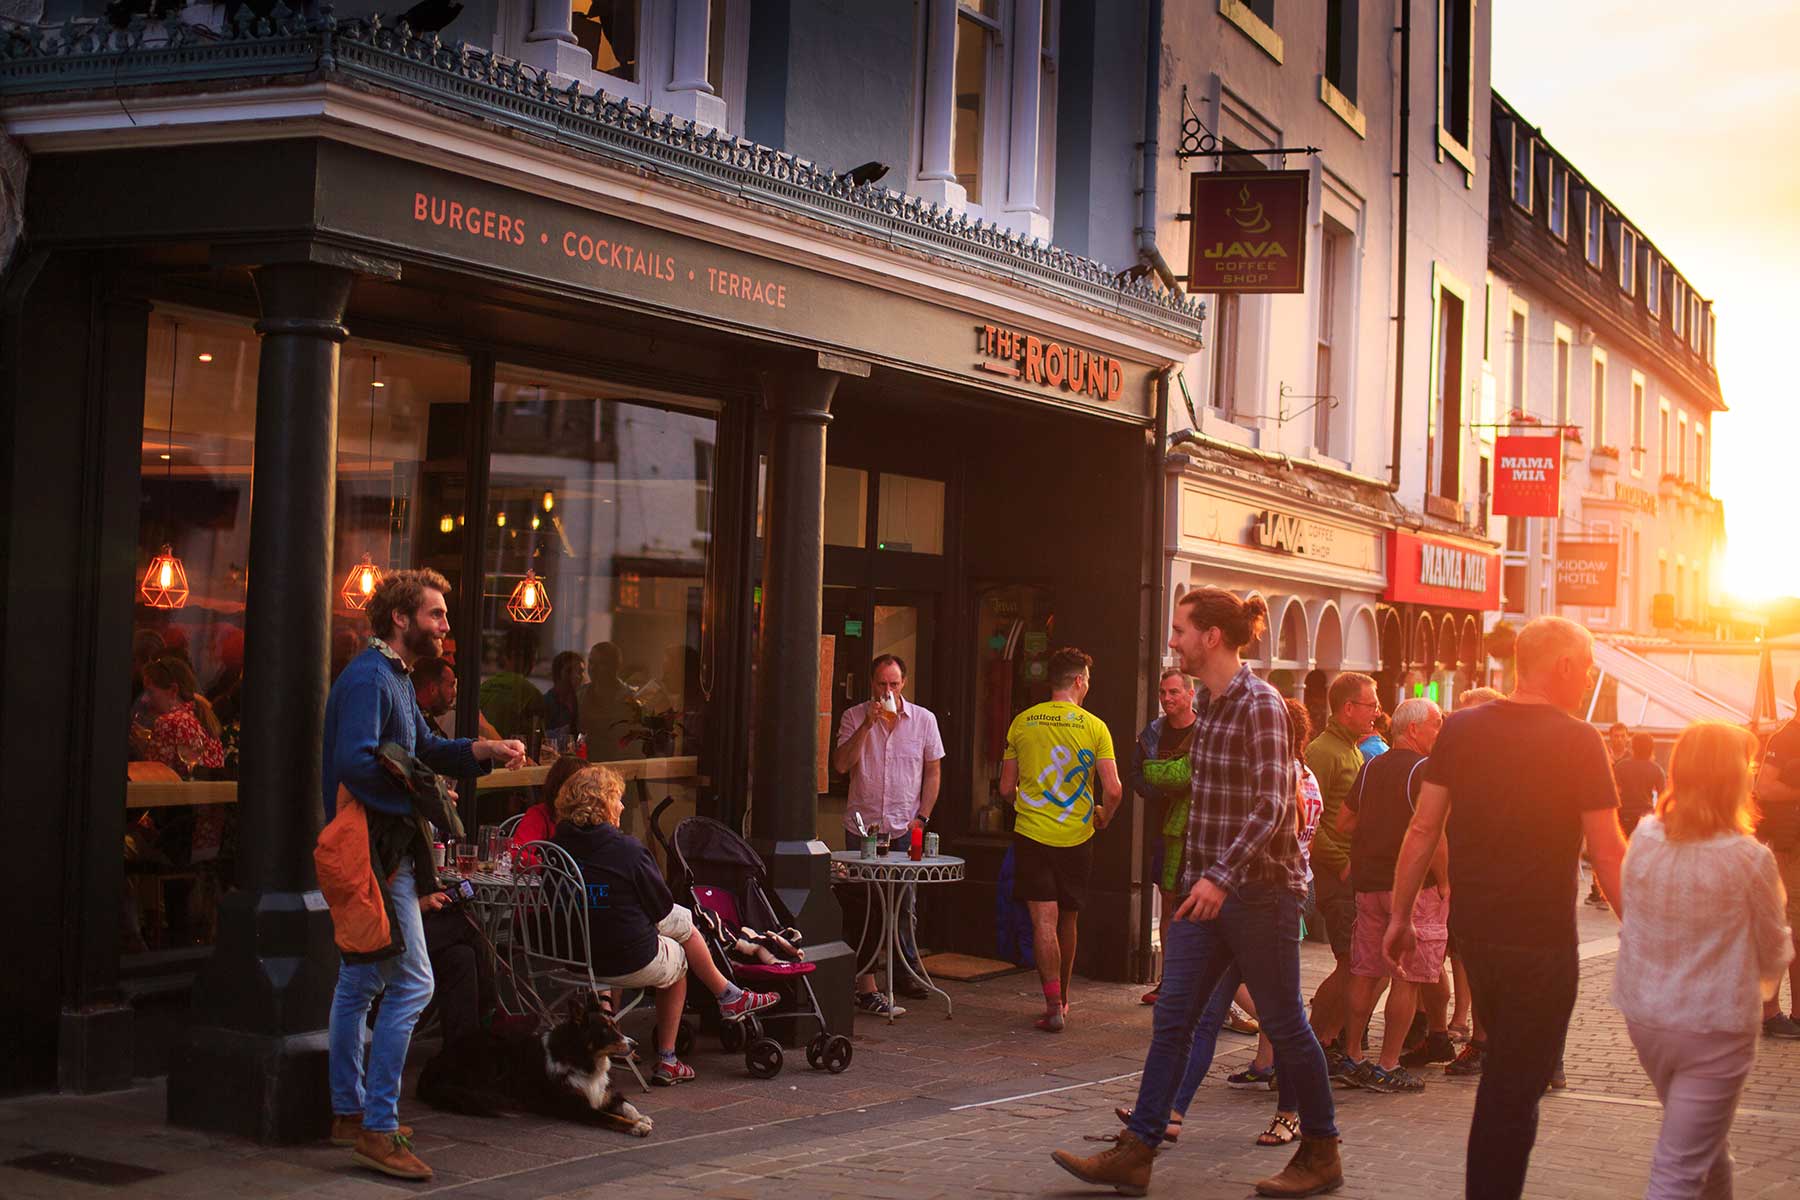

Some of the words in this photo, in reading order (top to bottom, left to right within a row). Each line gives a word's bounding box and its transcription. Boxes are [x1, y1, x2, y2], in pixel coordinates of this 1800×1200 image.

[414, 192, 526, 246] BURGERS
[562, 231, 675, 282] COCKTAILS
[708, 267, 787, 309] TERRACE
[1204, 242, 1287, 258] JAVA
[1215, 261, 1278, 272] COFFEE
[1223, 274, 1269, 284] SHOP
[984, 324, 1021, 361] THE
[1025, 335, 1124, 402] ROUND
[1501, 456, 1554, 470] MAMA
[1512, 470, 1546, 482] MIA
[1255, 510, 1307, 554] JAVA
[1421, 543, 1462, 589] MAMA
[1463, 552, 1487, 593] MIA
[1557, 573, 1600, 585] HOTEL
